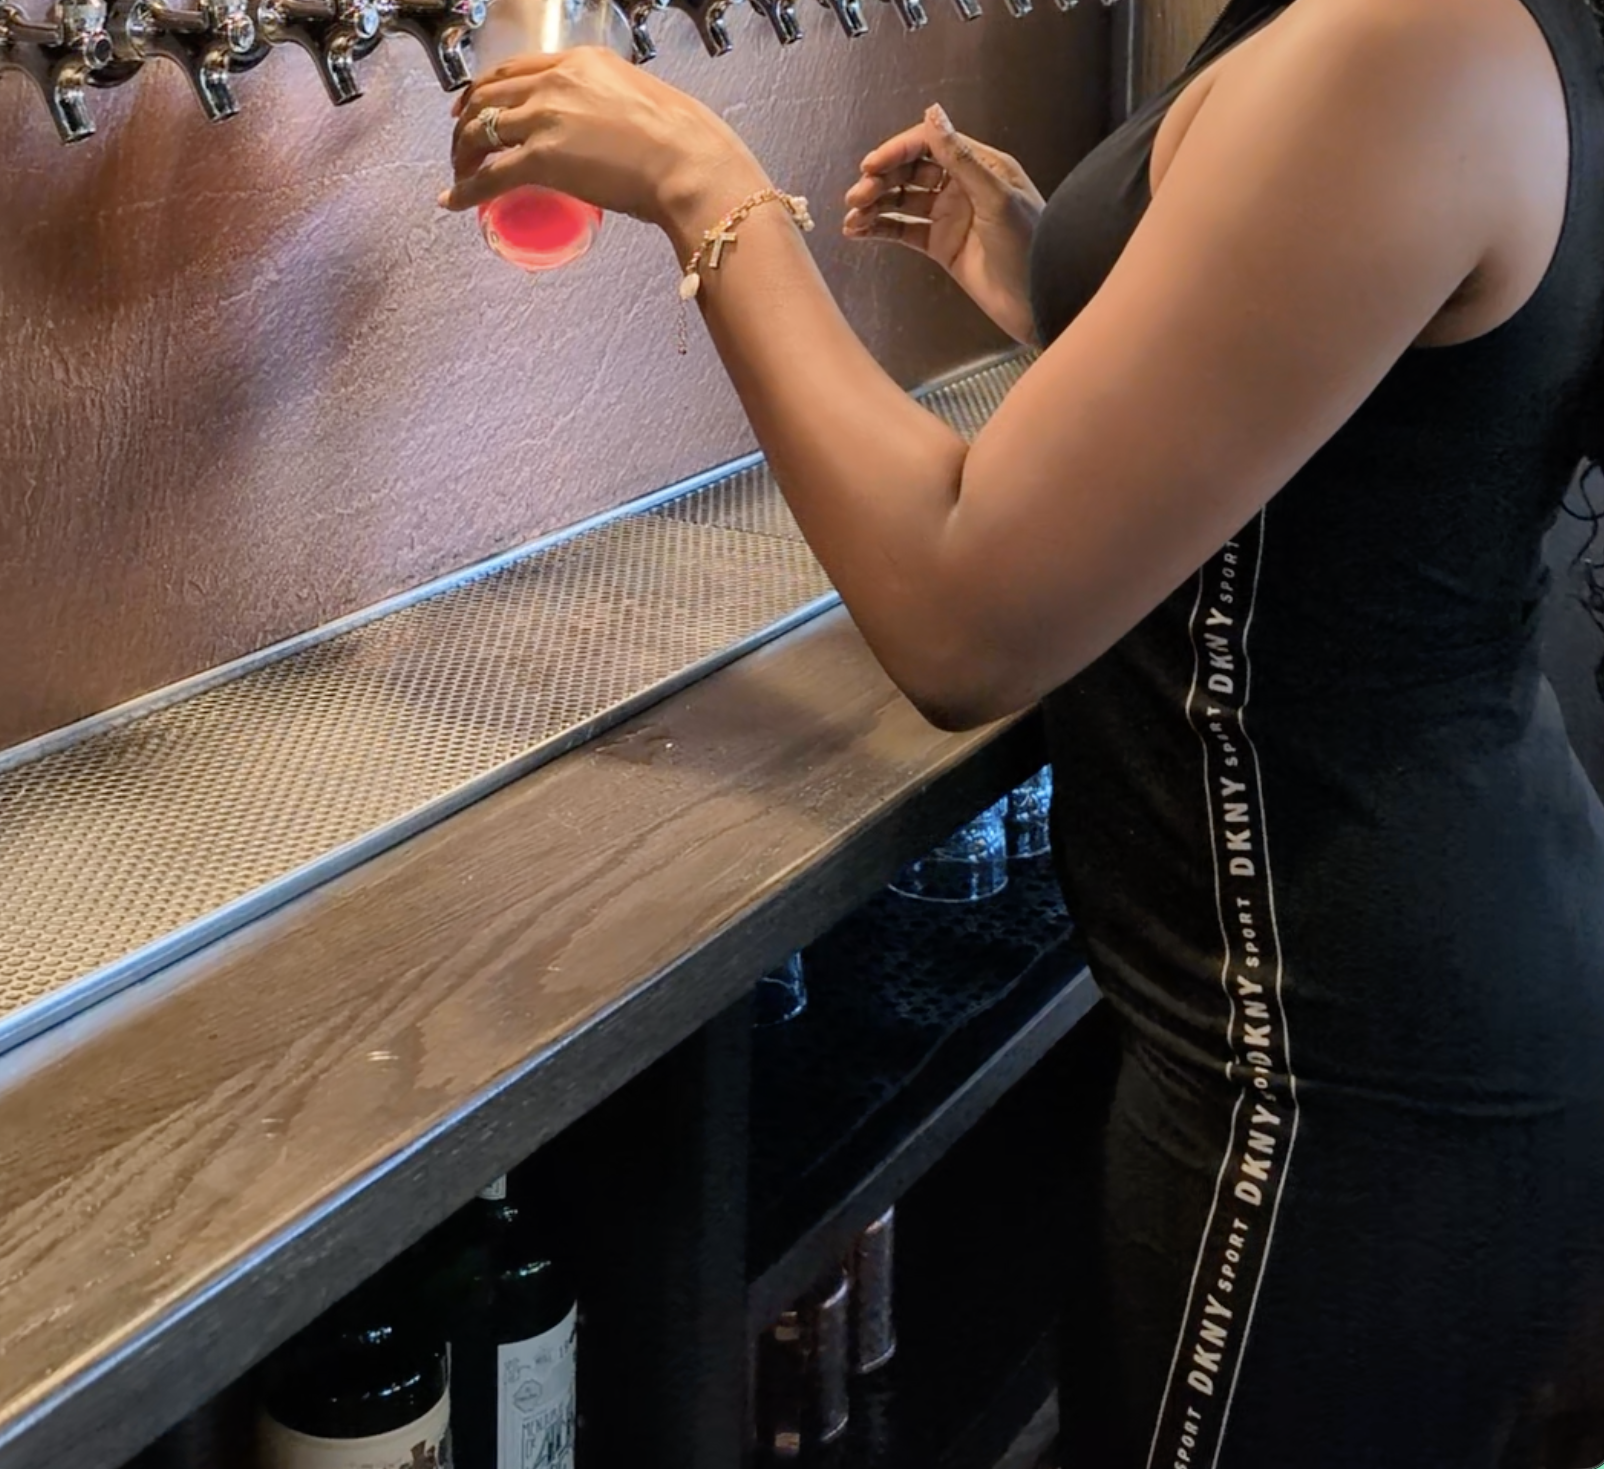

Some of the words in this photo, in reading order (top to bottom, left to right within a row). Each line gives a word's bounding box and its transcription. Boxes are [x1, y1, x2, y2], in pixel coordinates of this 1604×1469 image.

[1205, 607, 1234, 695] DKNY
[1220, 777, 1256, 877] DKNY
[1236, 897, 1260, 968] SPORT
[1236, 975, 1273, 1067] DKNY
[1234, 1104, 1281, 1206] DKNY
[1187, 1295, 1233, 1396] DKNY
[1217, 1218, 1250, 1293] SPORT
[1173, 1406, 1203, 1469] SPORT
